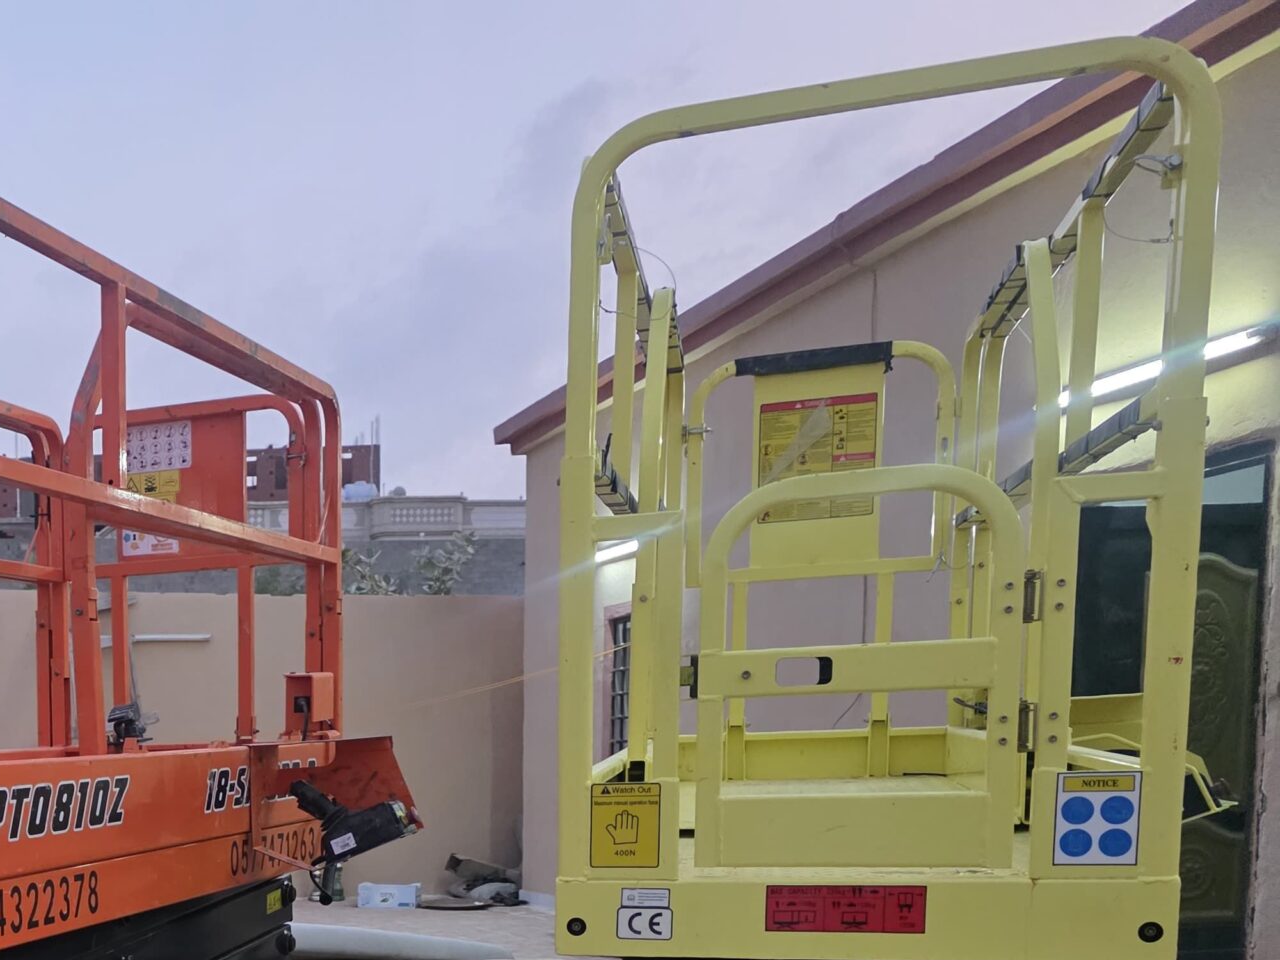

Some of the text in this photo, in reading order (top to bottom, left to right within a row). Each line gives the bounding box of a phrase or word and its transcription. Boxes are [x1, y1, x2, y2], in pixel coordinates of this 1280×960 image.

[1081, 779, 1119, 788] NOTICE
[612, 786, 635, 794] Watch
[628, 912, 663, 935] CE
